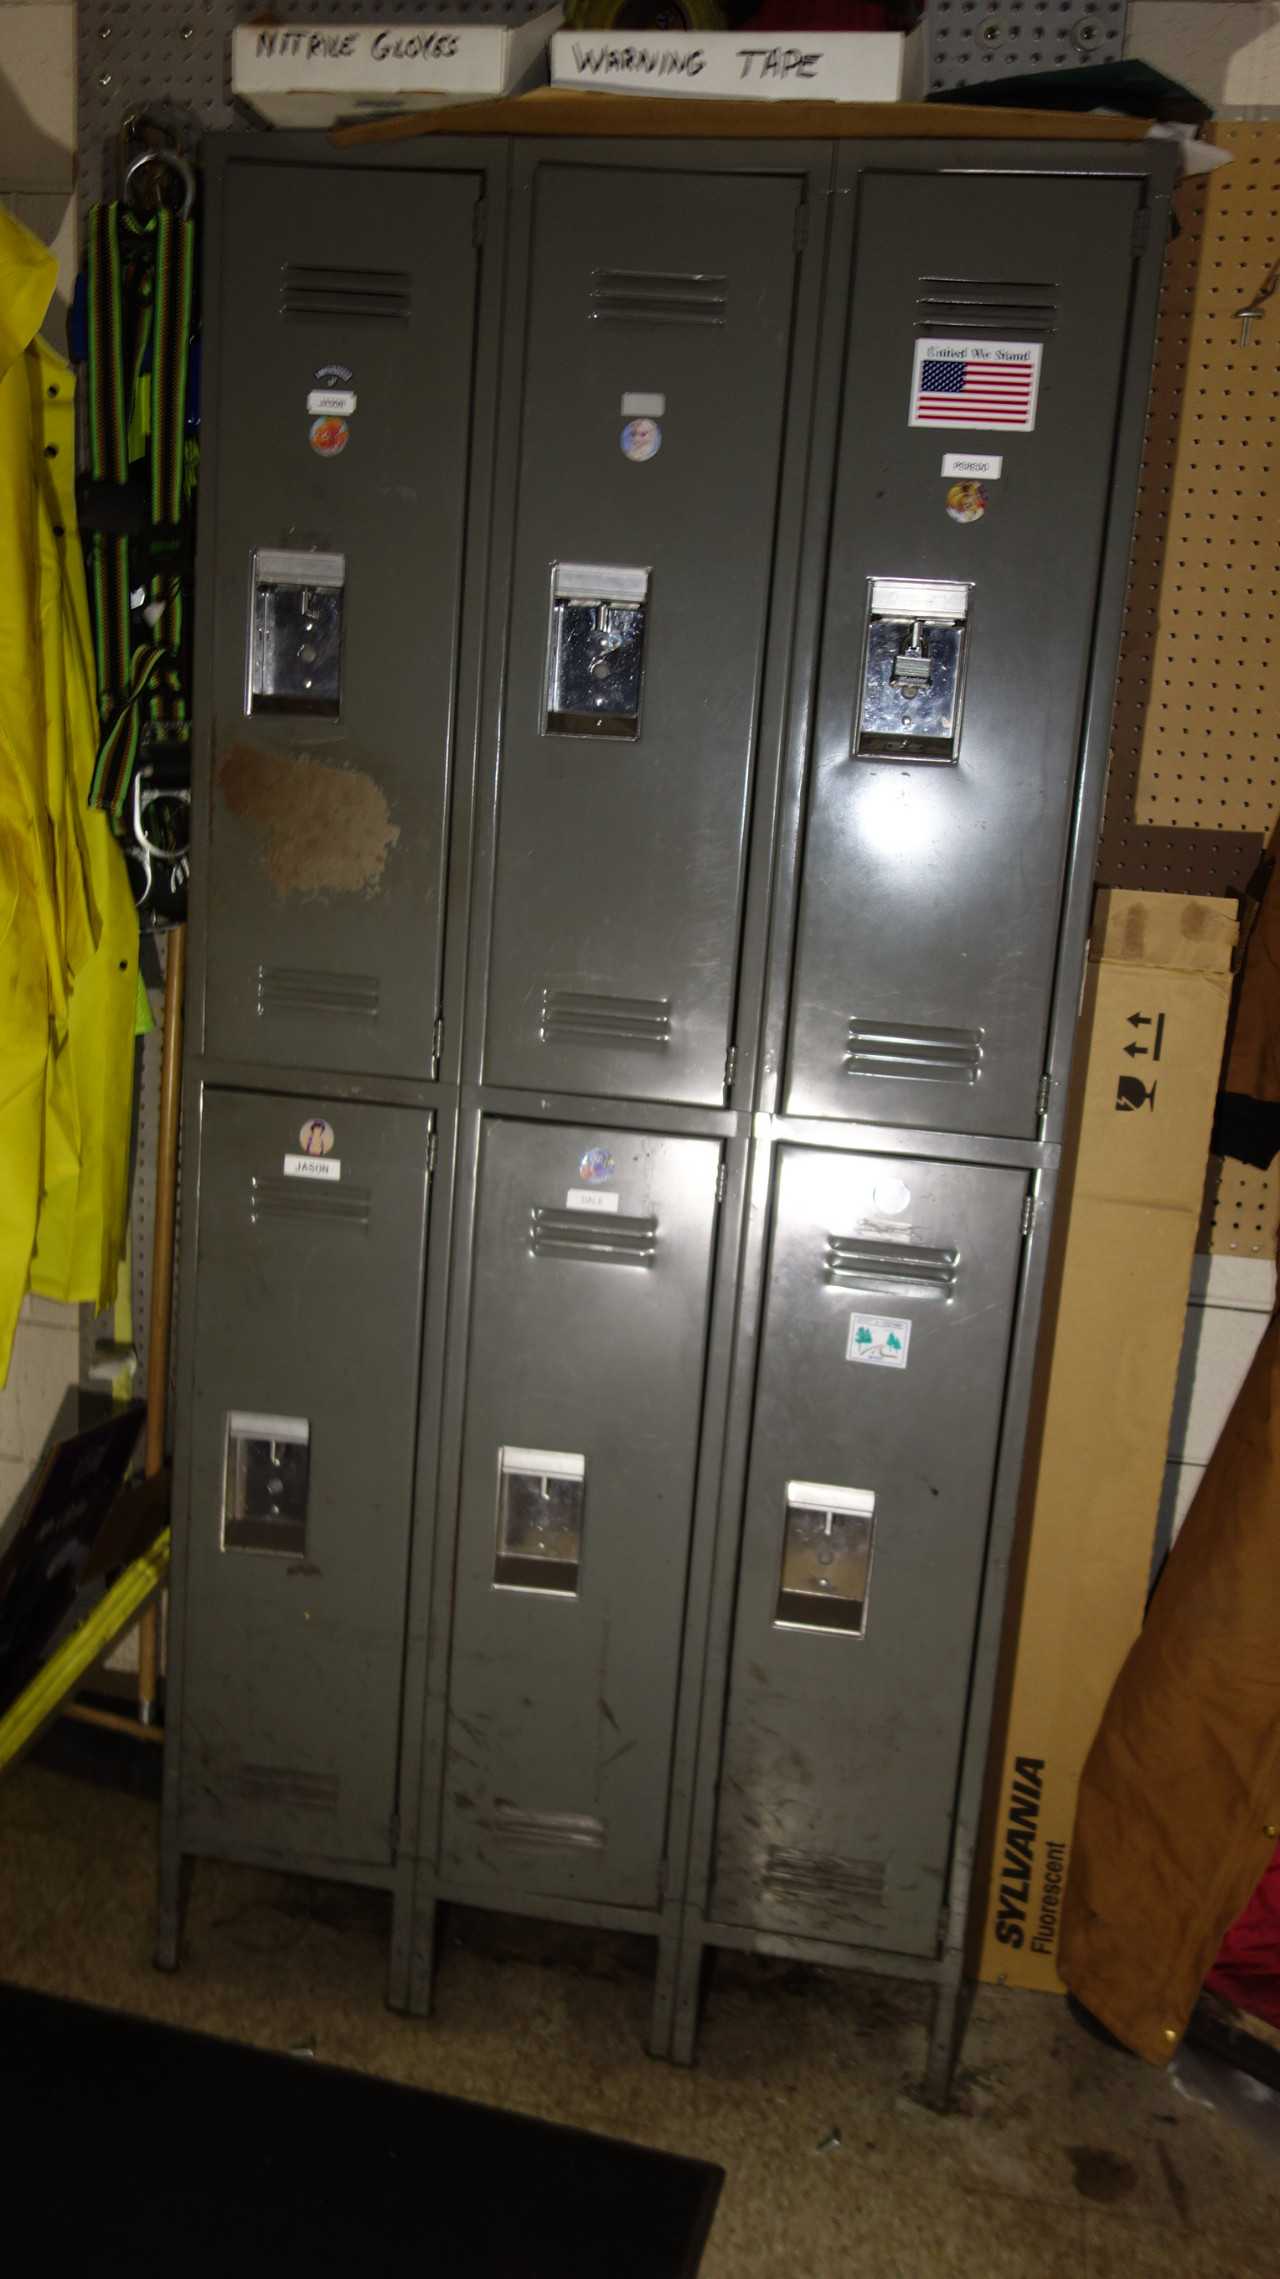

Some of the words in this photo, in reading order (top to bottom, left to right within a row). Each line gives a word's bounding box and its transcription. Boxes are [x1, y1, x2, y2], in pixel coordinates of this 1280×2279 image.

[256, 31, 358, 60] NITRILE
[371, 30, 460, 61] GLOVES
[572, 42, 706, 77] WARNING
[736, 46, 824, 79] TAPE
[927, 346, 967, 359] United
[970, 348, 991, 359] We
[994, 349, 1032, 361] Stand
[297, 1161, 329, 1174] JASON
[995, 1756, 1045, 1949] SYLVANIA
[1030, 1840, 1066, 1955] Fluorescent
